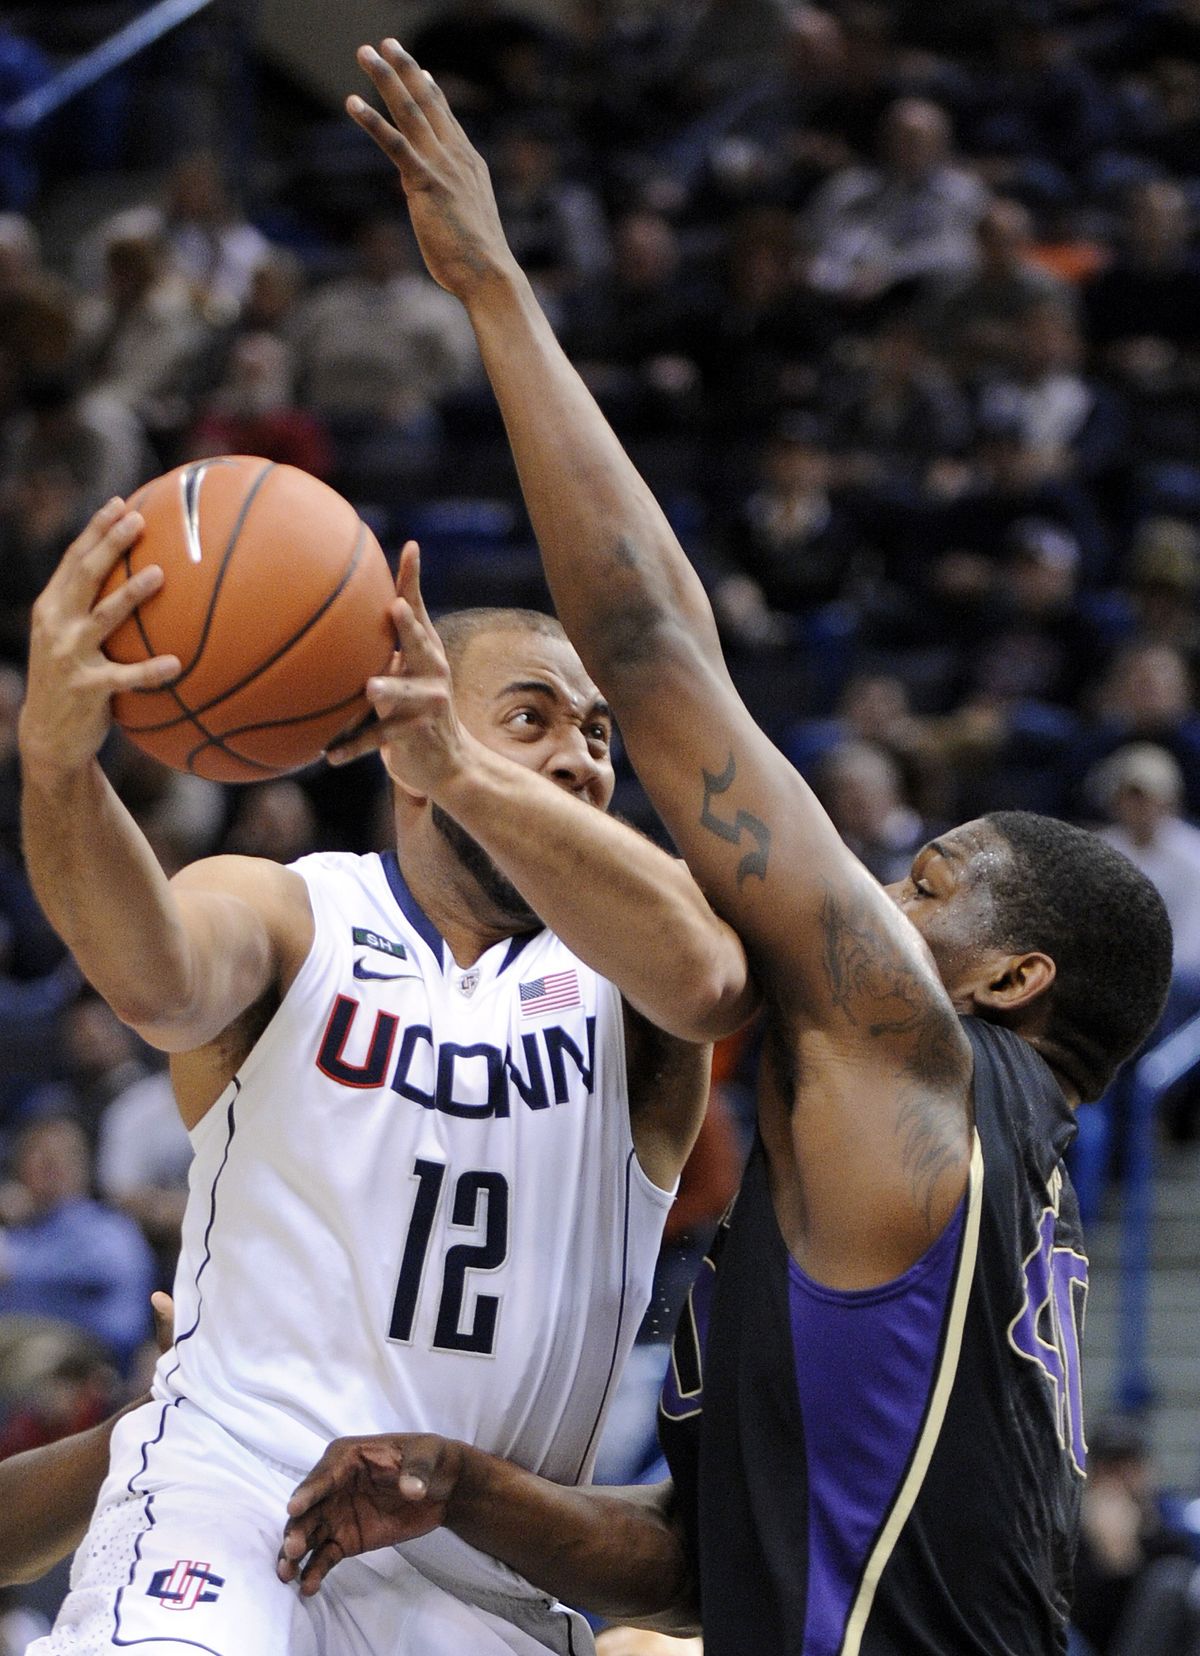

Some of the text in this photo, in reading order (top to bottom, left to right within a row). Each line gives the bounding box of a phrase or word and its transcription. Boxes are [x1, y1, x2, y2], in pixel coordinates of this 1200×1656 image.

[366, 933, 393, 952] SH
[315, 993, 595, 1119] UCONN
[386, 1157, 510, 1359] 12
